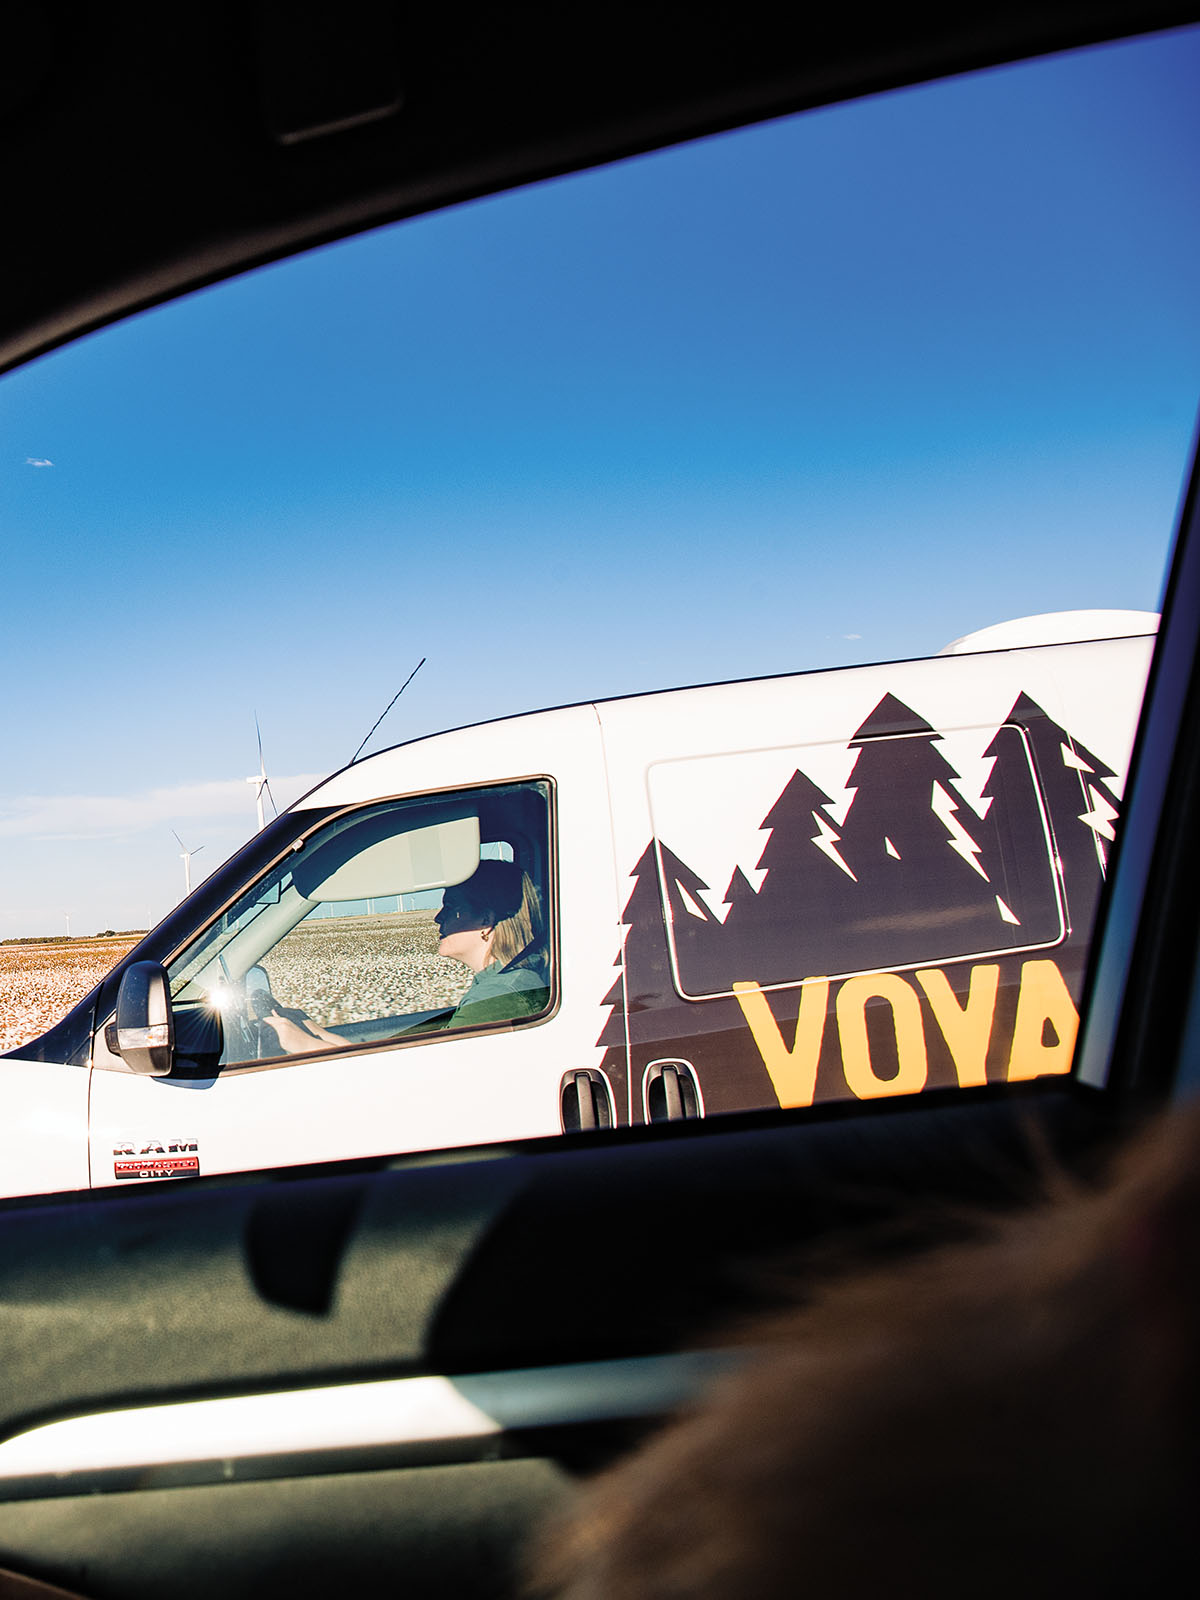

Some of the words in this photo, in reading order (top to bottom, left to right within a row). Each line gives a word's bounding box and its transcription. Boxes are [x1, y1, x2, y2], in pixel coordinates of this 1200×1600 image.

[732, 959, 1080, 1110] VOYA
[113, 1137, 198, 1156] RAM
[139, 1169, 174, 1178] CITY
